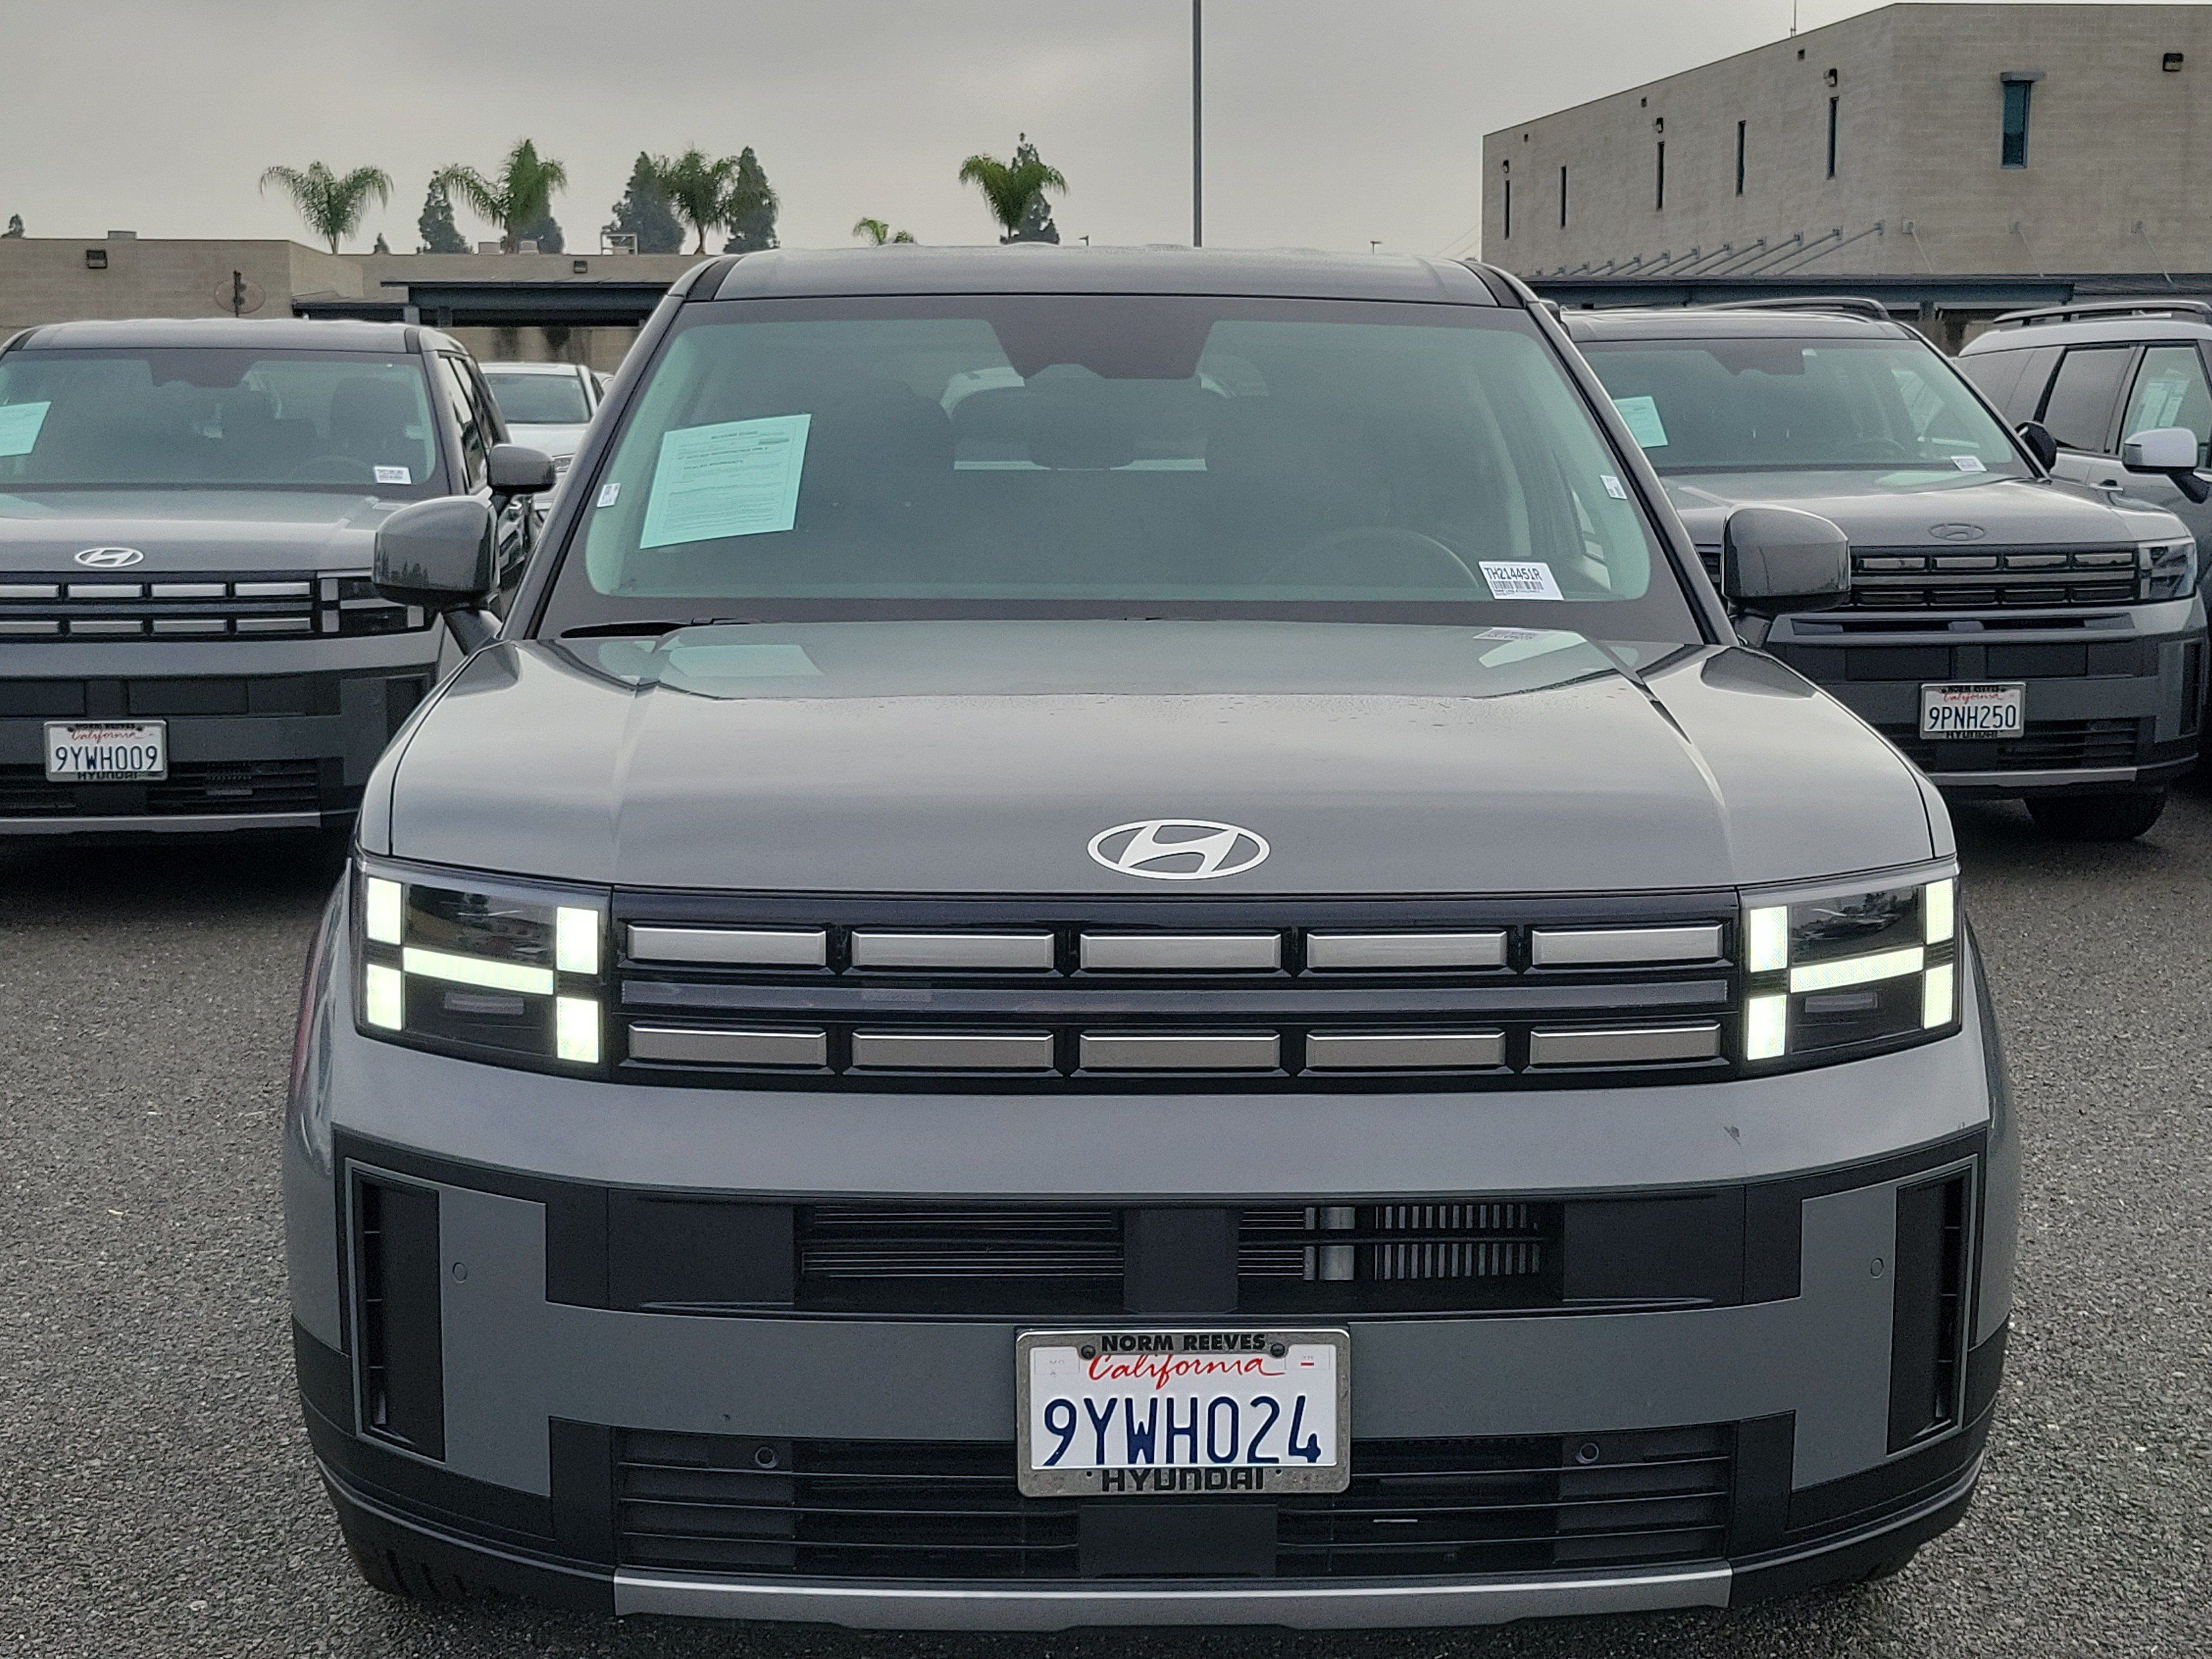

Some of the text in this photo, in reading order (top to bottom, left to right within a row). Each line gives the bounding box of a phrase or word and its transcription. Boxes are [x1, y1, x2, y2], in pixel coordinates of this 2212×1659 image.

[1483, 567, 1543, 580] TH214451R
[1928, 705, 2016, 730] 9PNH250
[55, 745, 157, 771] 9YWH009
[1101, 1333, 1266, 1352] NORM REEVES
[1088, 1355, 1285, 1390] California
[1042, 1395, 1322, 1465] 9YWH024
[1102, 1467, 1263, 1492] HYUNDAI
